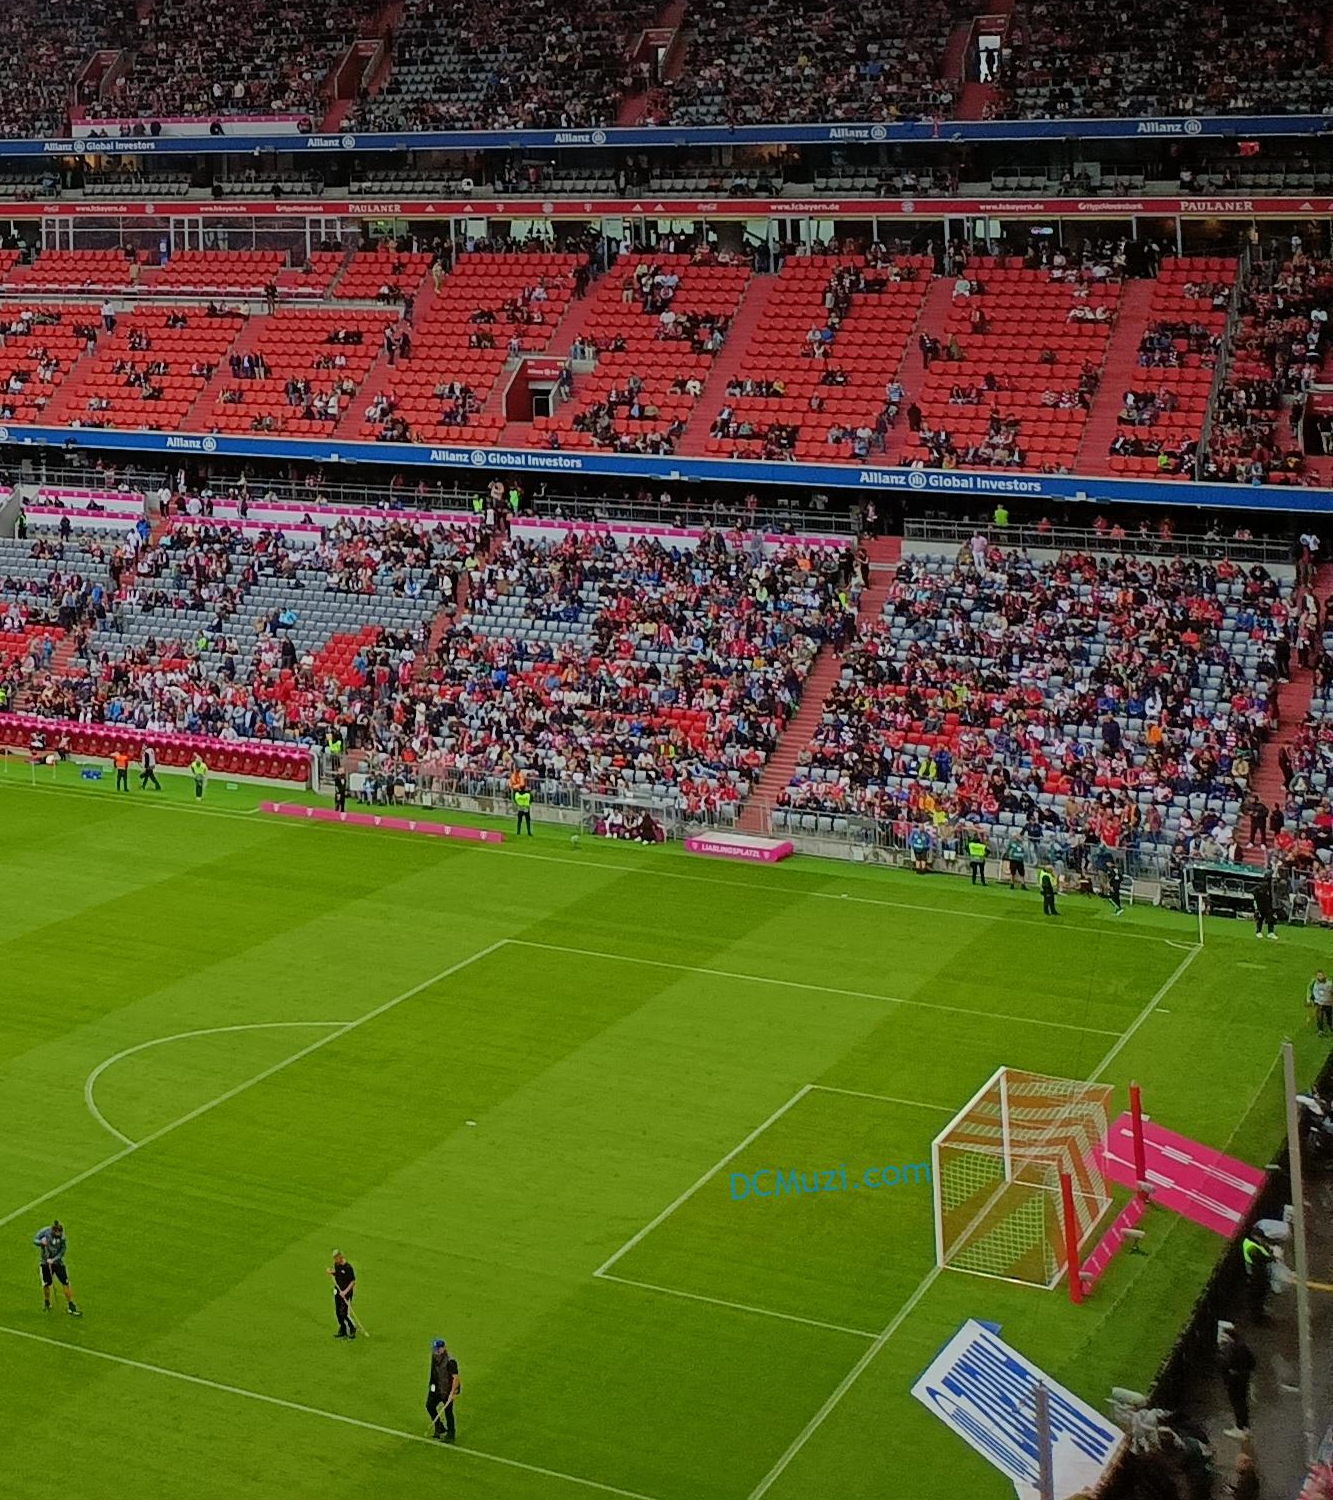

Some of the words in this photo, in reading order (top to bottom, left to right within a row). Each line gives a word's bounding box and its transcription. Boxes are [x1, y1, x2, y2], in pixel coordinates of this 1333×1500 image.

[1138, 122, 1181, 132] Allianz
[829, 128, 869, 137] Allianz
[307, 138, 340, 147] Allianz
[554, 134, 590, 142] Allianz
[44, 143, 72, 151] Allianz
[86, 142, 114, 150] Global
[115, 141, 155, 149] Investors
[349, 204, 401, 213] PAULANER
[1180, 201, 1254, 211] PAULANER
[166, 437, 201, 448] Allianz
[430, 450, 469, 462] Allianz
[488, 453, 525, 465] Global
[527, 455, 582, 467] Investors
[860, 471, 906, 485] Allianz
[929, 475, 974, 488] Global
[977, 477, 1041, 491] Investors
